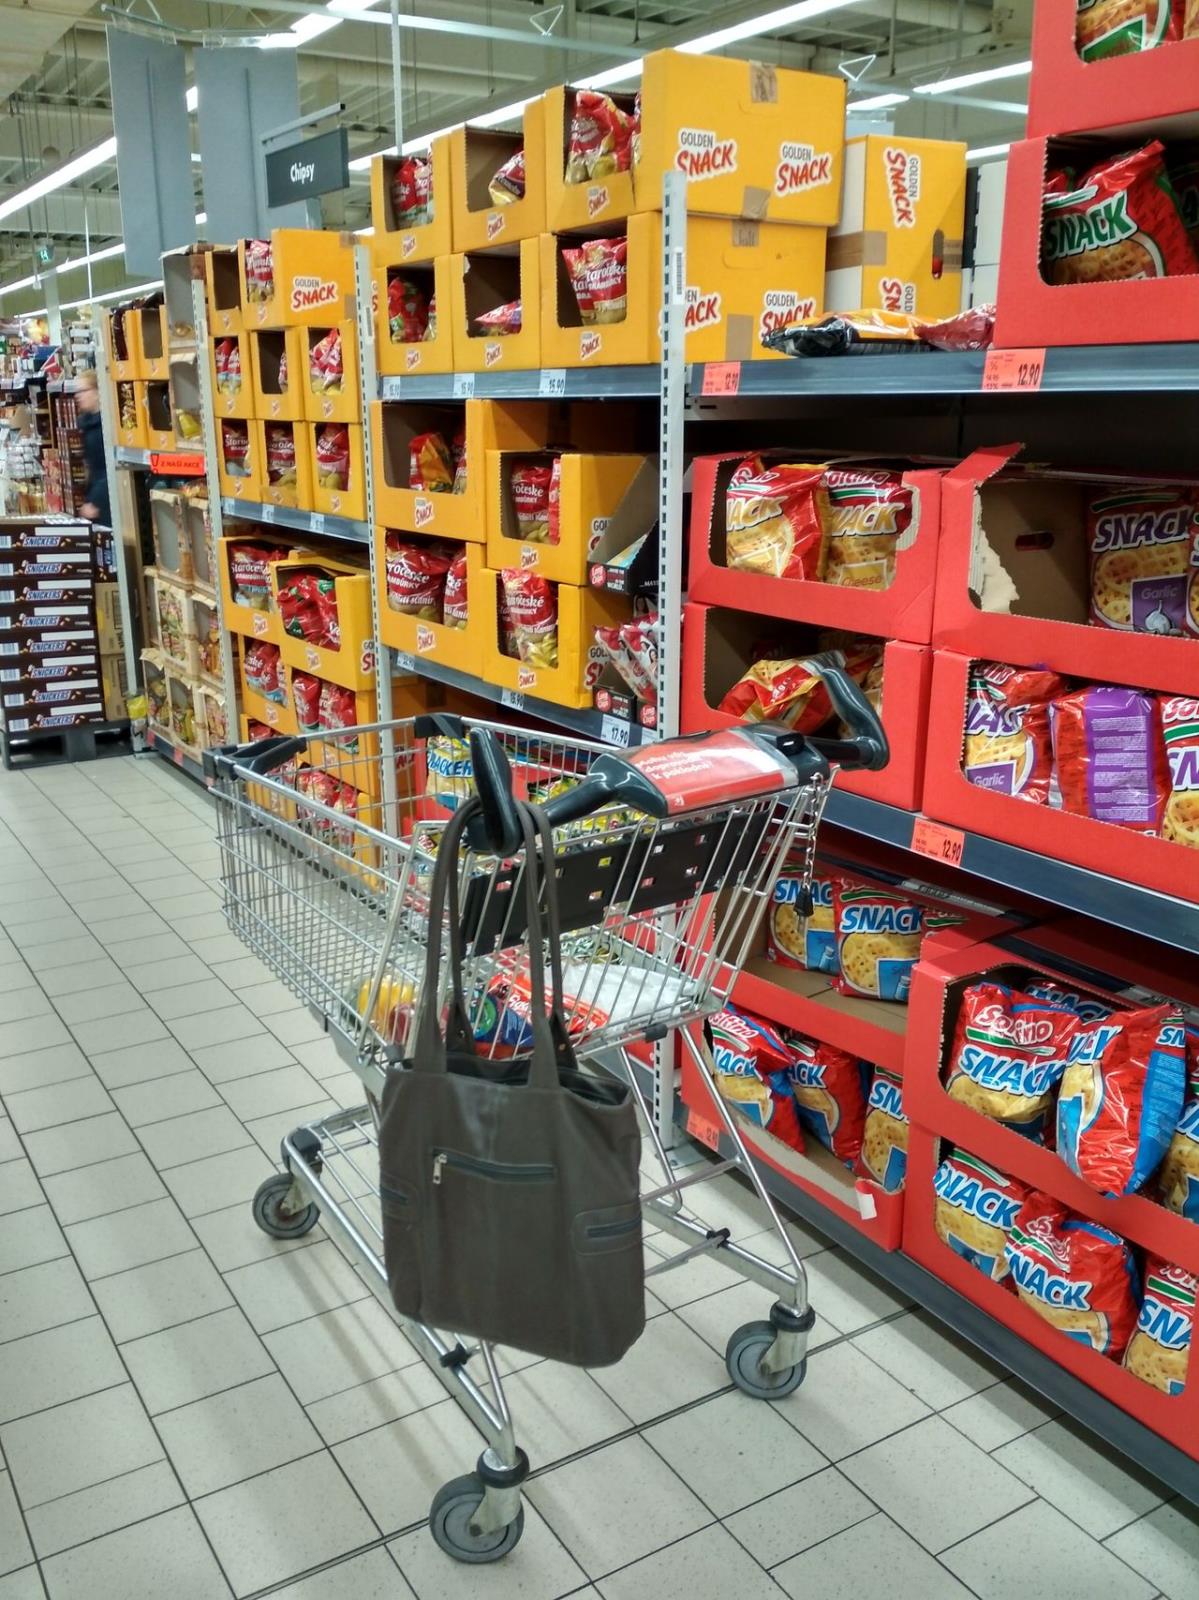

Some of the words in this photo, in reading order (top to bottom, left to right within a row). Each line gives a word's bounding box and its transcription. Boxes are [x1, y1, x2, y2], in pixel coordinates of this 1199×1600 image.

[680, 131, 714, 149] GOLDEN
[676, 143, 734, 176] SNACK
[782, 145, 812, 161] GOLDEN
[290, 162, 315, 184] Chipsy
[777, 157, 829, 192] SNACK
[908, 157, 919, 199] GOLDEN
[887, 150, 913, 224] SNACK
[1043, 190, 1138, 258] SNACK
[294, 278, 320, 288] GOLDEN
[292, 284, 335, 308] SNACK
[685, 289, 698, 302] EN
[765, 293, 796, 307] GOLDEN
[1017, 363, 1041, 386] 12.90
[24, 536, 59, 547] SNICKERS
[26, 563, 61, 574] SNICKERS
[843, 576, 882, 587] Cheese
[27, 590, 62, 600] SNICKERS
[1141, 585, 1179, 600] Garlic
[23, 616, 58, 627] SNICKERS
[31, 641, 65, 652] SNICKERS
[32, 667, 65, 677] SNICKERS
[37, 691, 70, 702] SNICKERS
[41, 716, 74, 727] SNICKERS
[611, 725, 628, 744] 17.90
[973, 771, 1006, 787] Garlic
[942, 839, 962, 862] 12.90
[959, 1046, 1067, 1096] SNACK
[869, 1080, 905, 1120] SN
[933, 1162, 1023, 1229] SNACK
